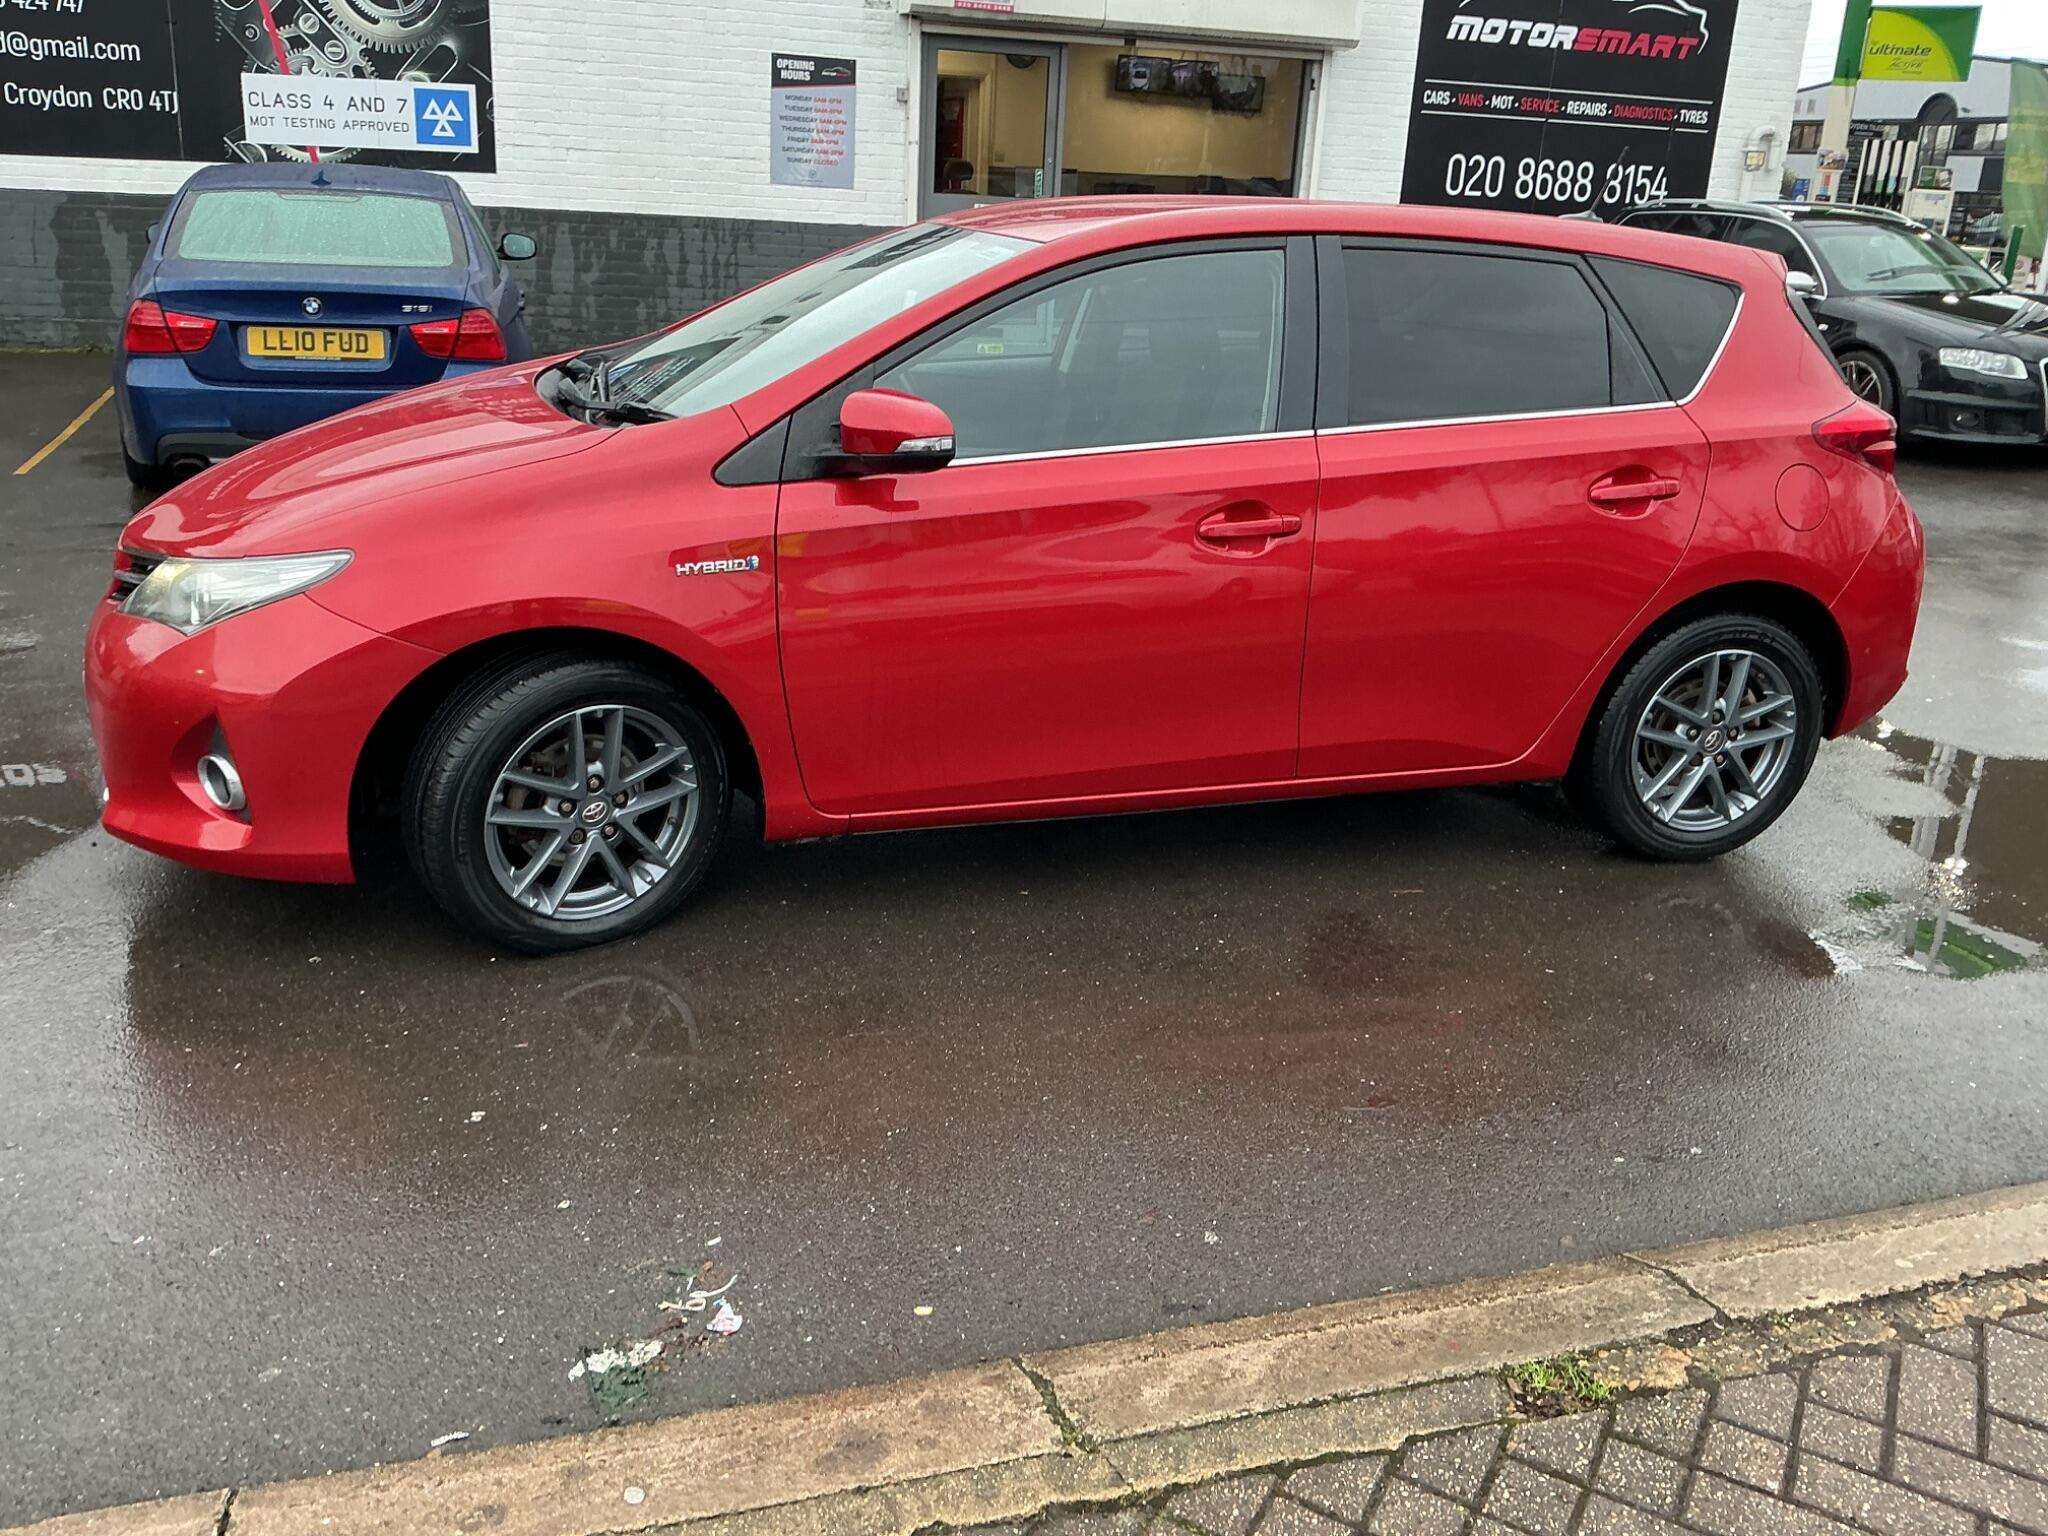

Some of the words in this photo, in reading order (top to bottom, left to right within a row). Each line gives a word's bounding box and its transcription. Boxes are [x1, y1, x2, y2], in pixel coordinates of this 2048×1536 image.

[1446, 14, 1700, 60] MOTORSMART
[776, 58, 815, 71] OPENING
[781, 69, 811, 81] HOURS
[3, 82, 93, 111] Croydon
[149, 90, 179, 114] 4TJ
[248, 91, 312, 109] CLASS
[323, 95, 335, 109] 4
[346, 97, 385, 113] AND
[396, 98, 408, 114] 7
[1423, 89, 1450, 105] CARS
[1458, 93, 1484, 108] VANS
[1491, 95, 1514, 109] MOT
[1520, 97, 1560, 113] SERVICE
[1567, 101, 1607, 117] REPAIRS
[1614, 103, 1674, 122] DIAGNOSTICS
[1680, 108, 1708, 125] TYRES
[250, 116, 275, 126] MOT
[282, 117, 336, 129] TESTING
[343, 120, 410, 133] APPROVED
[1445, 153, 1506, 198] 020
[1515, 157, 1594, 202] 8688
[1604, 163, 1668, 206] 8154
[262, 329, 316, 352] LL10
[323, 331, 369, 354] FUD
[675, 559, 748, 576] HYBRID
